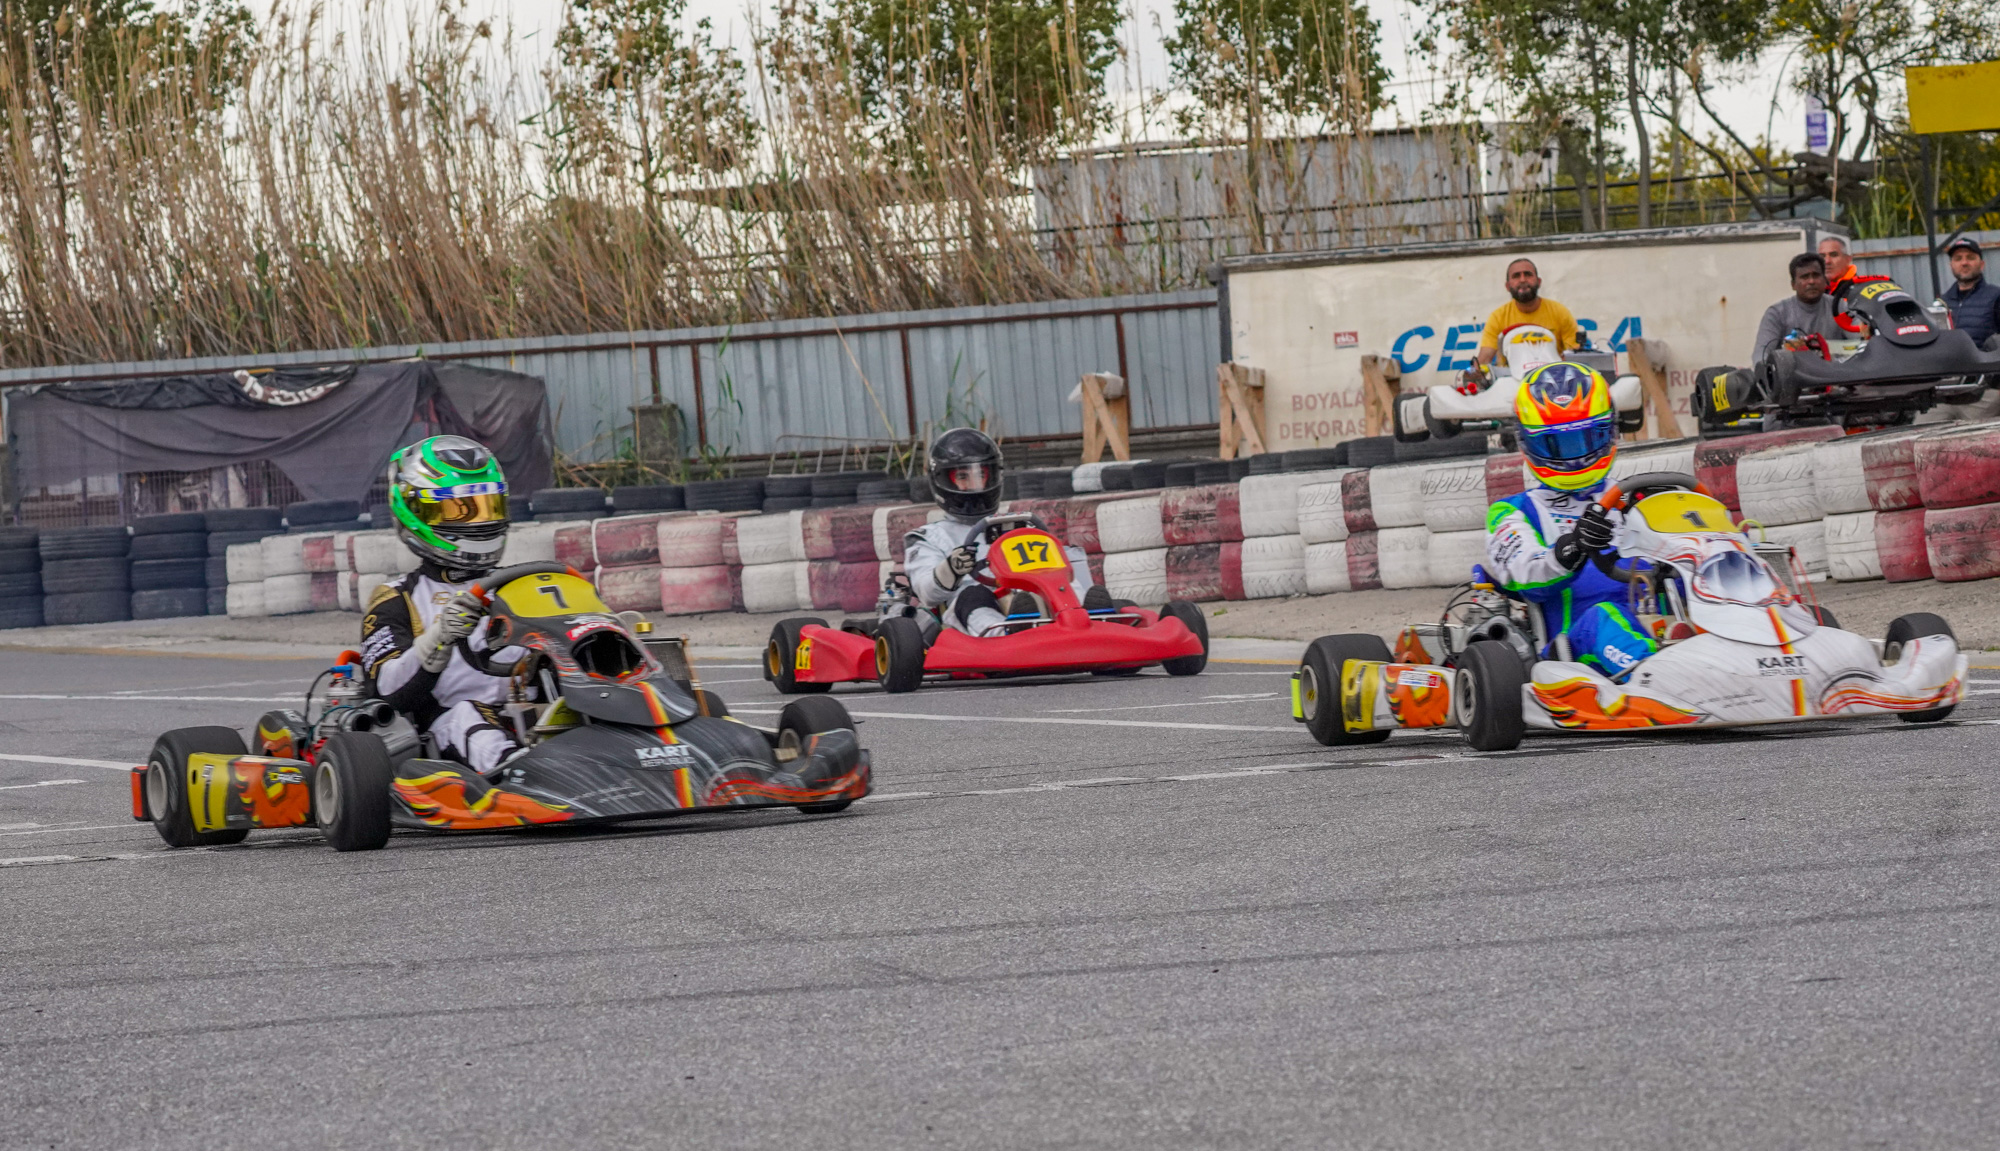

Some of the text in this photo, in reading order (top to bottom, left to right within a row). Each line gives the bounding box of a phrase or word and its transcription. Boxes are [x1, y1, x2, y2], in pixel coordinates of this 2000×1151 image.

[1682, 511, 1709, 528] 1
[1012, 541, 1049, 566] 17
[536, 585, 570, 609] 7
[1757, 655, 1805, 669] KART
[634, 744, 692, 760] KART
